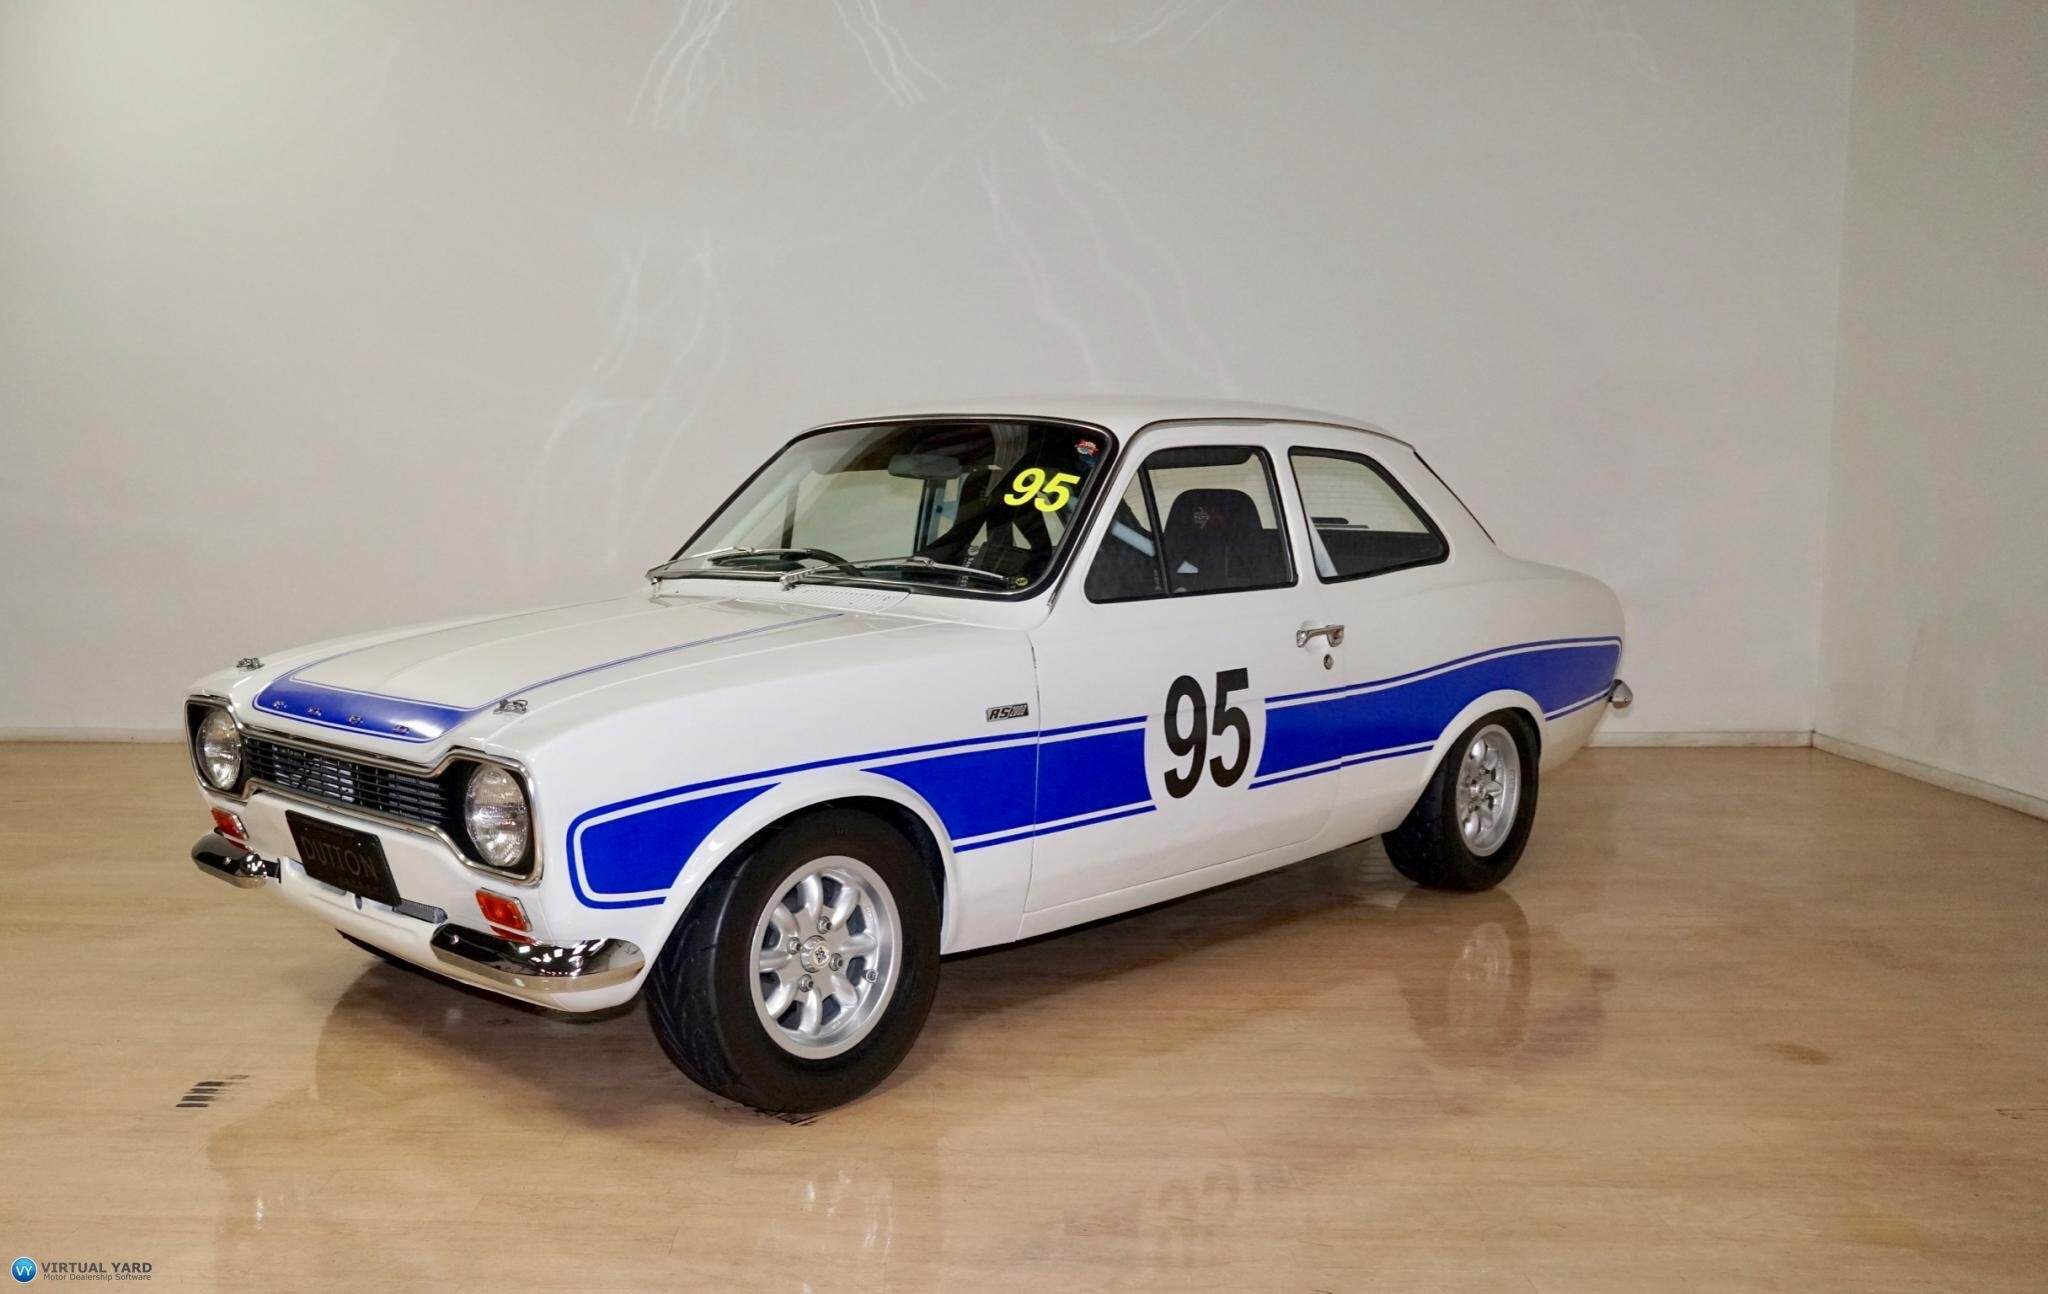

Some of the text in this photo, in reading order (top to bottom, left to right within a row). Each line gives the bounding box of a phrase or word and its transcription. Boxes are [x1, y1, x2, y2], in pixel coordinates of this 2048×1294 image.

[1003, 467, 1081, 513] 95
[1163, 667, 1251, 799] 95
[300, 835, 379, 881] DUTTON
